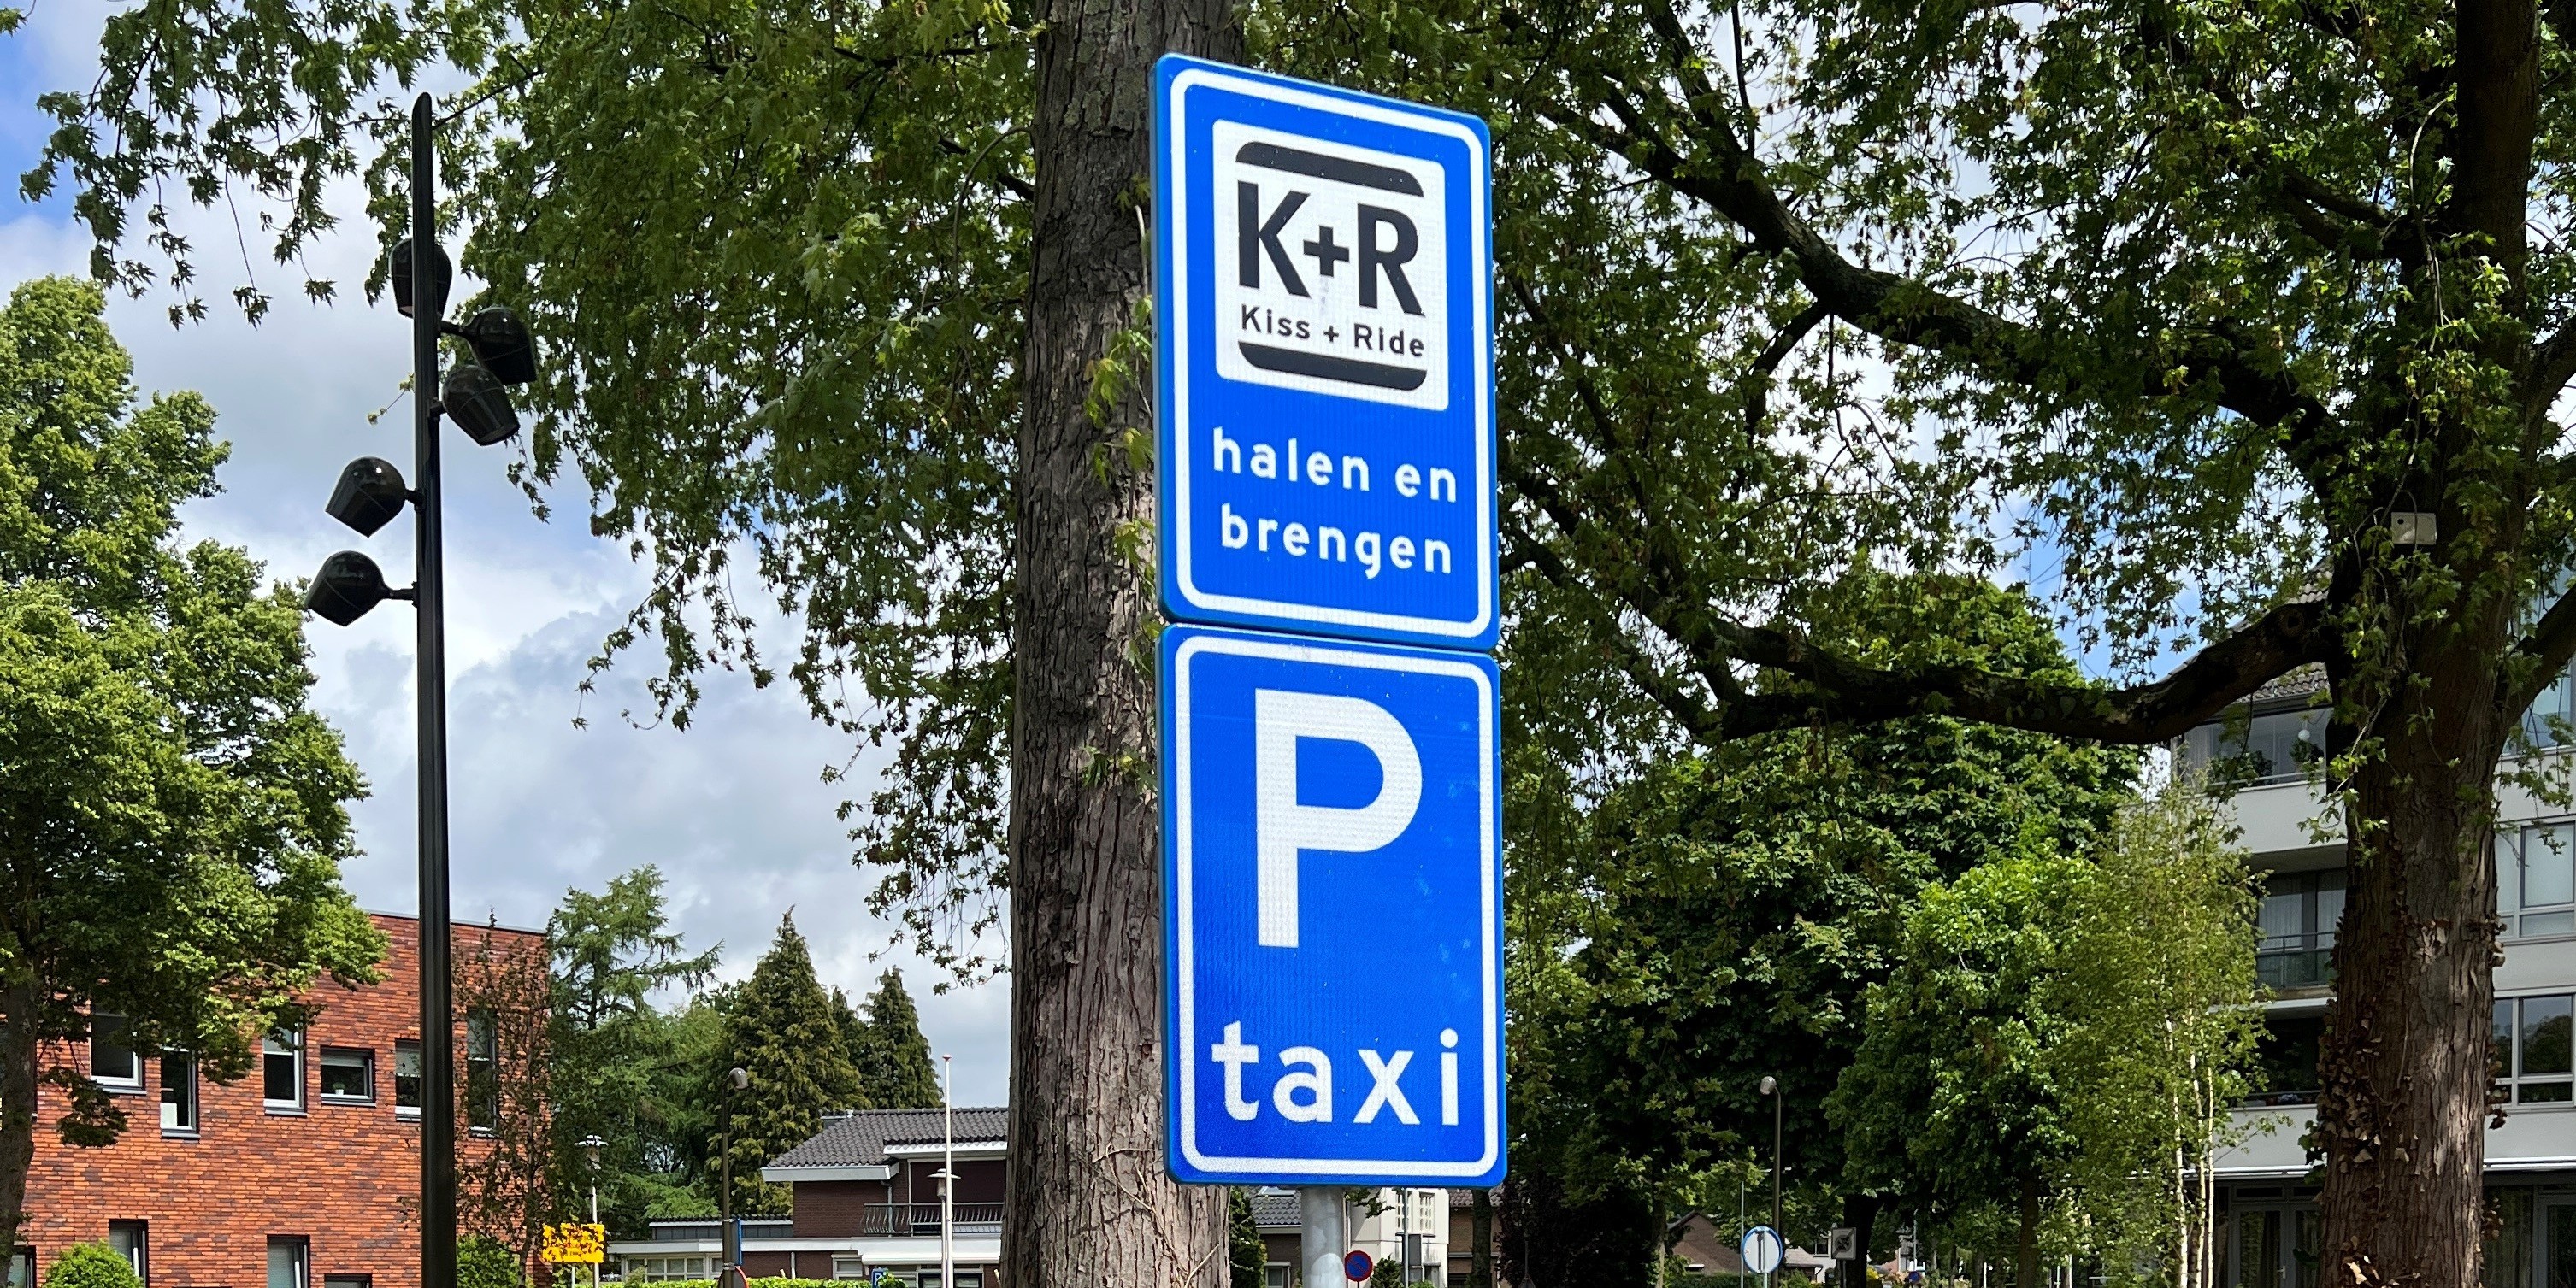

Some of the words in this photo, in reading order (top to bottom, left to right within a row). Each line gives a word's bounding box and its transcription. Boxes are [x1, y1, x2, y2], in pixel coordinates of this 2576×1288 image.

[1237, 180, 1425, 317] K+R
[1241, 304, 1311, 340] Kiss
[1323, 325, 1340, 343] +
[1353, 323, 1425, 357] Ride
[1213, 426, 1370, 491] halen
[1395, 463, 1457, 503] en
[1221, 503, 1451, 579] brengen
[1255, 688, 1423, 948] P
[1211, 1020, 1460, 1126] taxi
